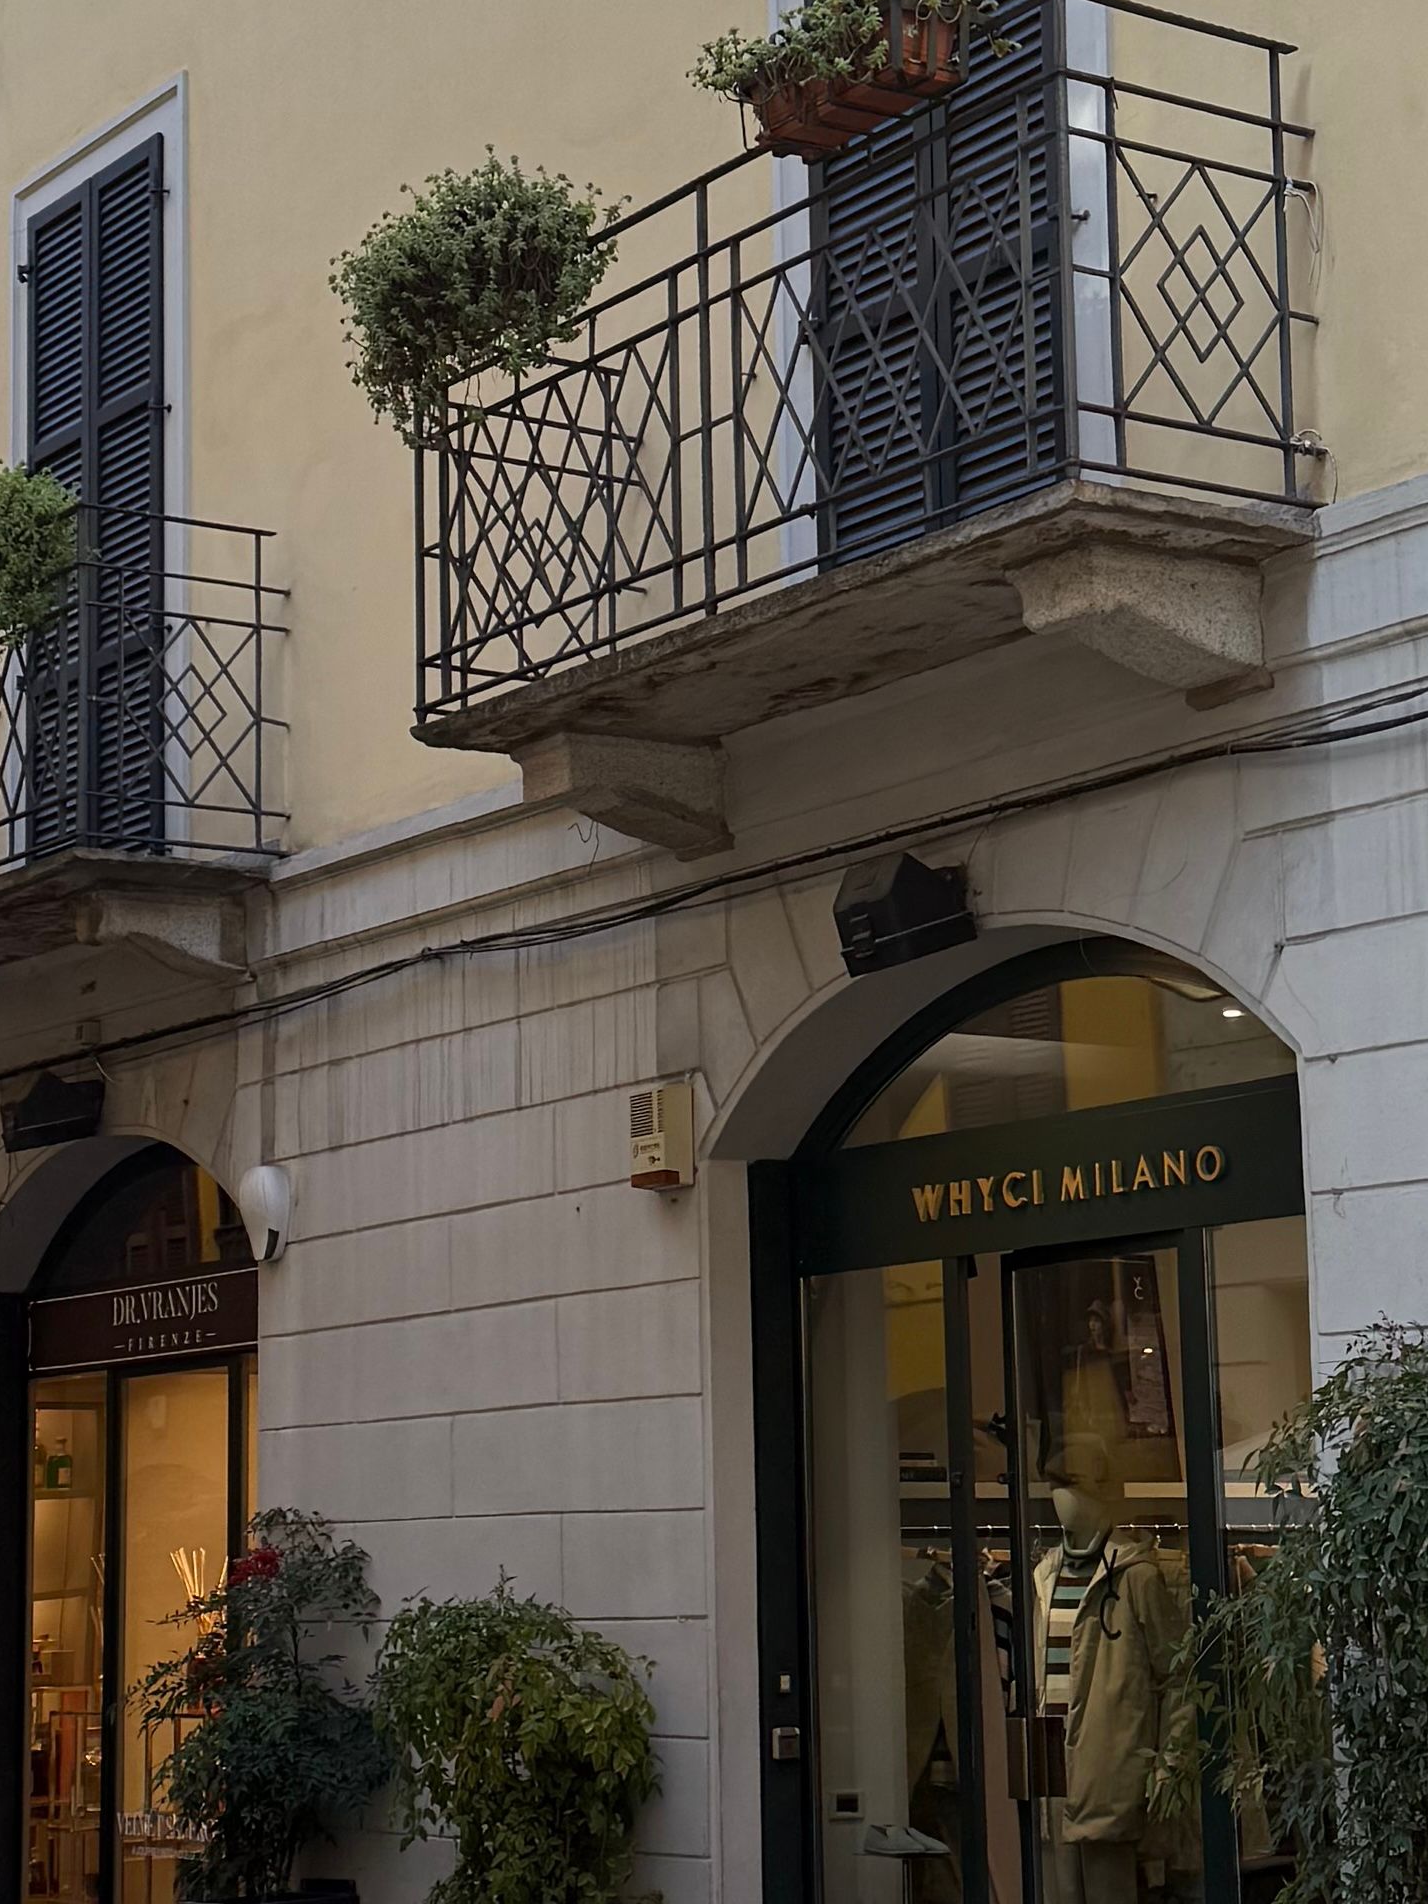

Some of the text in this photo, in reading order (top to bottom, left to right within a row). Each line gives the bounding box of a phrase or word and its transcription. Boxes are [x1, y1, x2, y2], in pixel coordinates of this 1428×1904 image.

[911, 1146, 1224, 1222] WHYCI MILANO
[128, 1329, 201, 1352] FIRENZE
